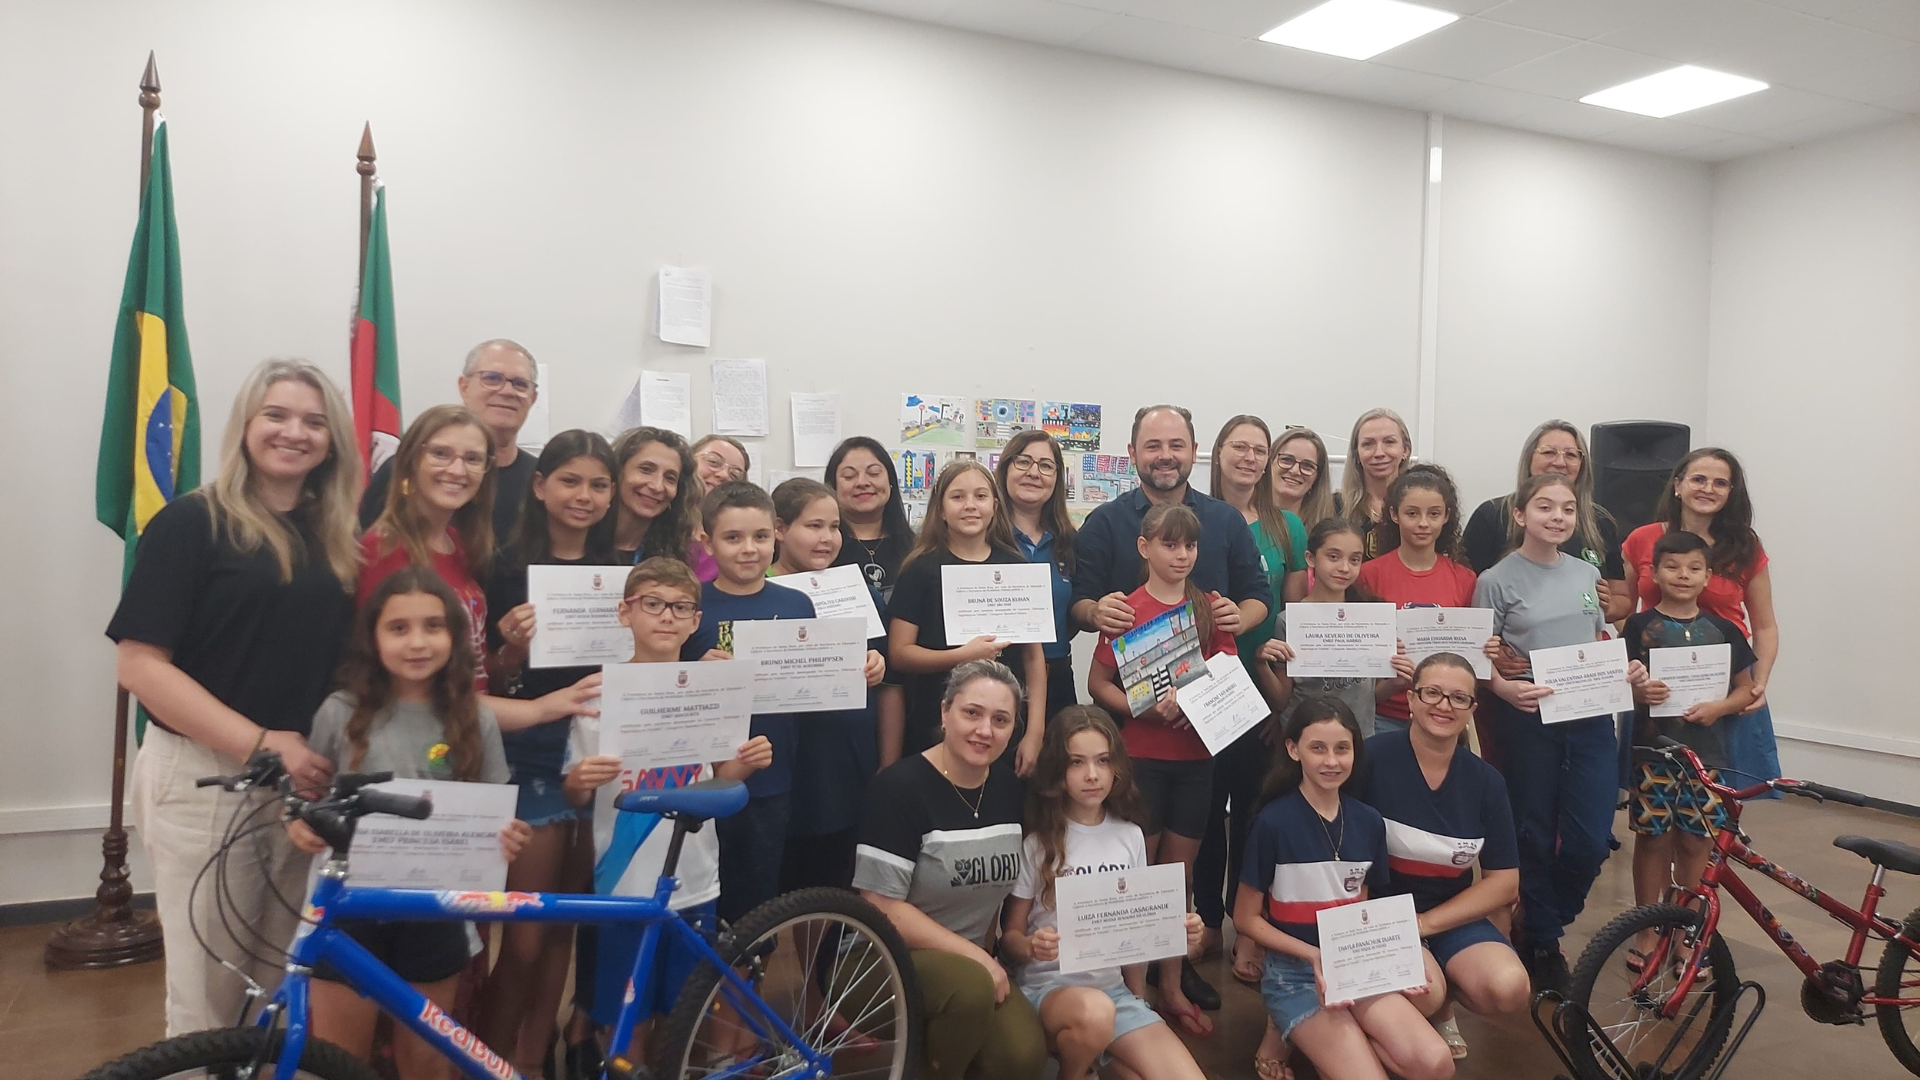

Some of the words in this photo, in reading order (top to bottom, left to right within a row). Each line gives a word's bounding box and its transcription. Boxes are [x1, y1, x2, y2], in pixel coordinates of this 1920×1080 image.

[808, 656, 843, 664] PHILIPPSEN
[1545, 677, 1559, 685] JÚLIA
[1558, 675, 1583, 683] VALENTINA
[640, 706, 682, 715] GUILHERME
[683, 703, 720, 712] MATTIAZZI
[621, 764, 703, 793] SAVVY
[972, 852, 1020, 884] GLÓRI
[1078, 913, 1095, 921] LUIZA
[1097, 909, 1129, 919] FERNANDA
[1130, 903, 1169, 914] CASAGRANDE
[1381, 934, 1401, 943] DUARTE
[418, 998, 470, 1050] Red
[469, 1034, 514, 1080] Bull
